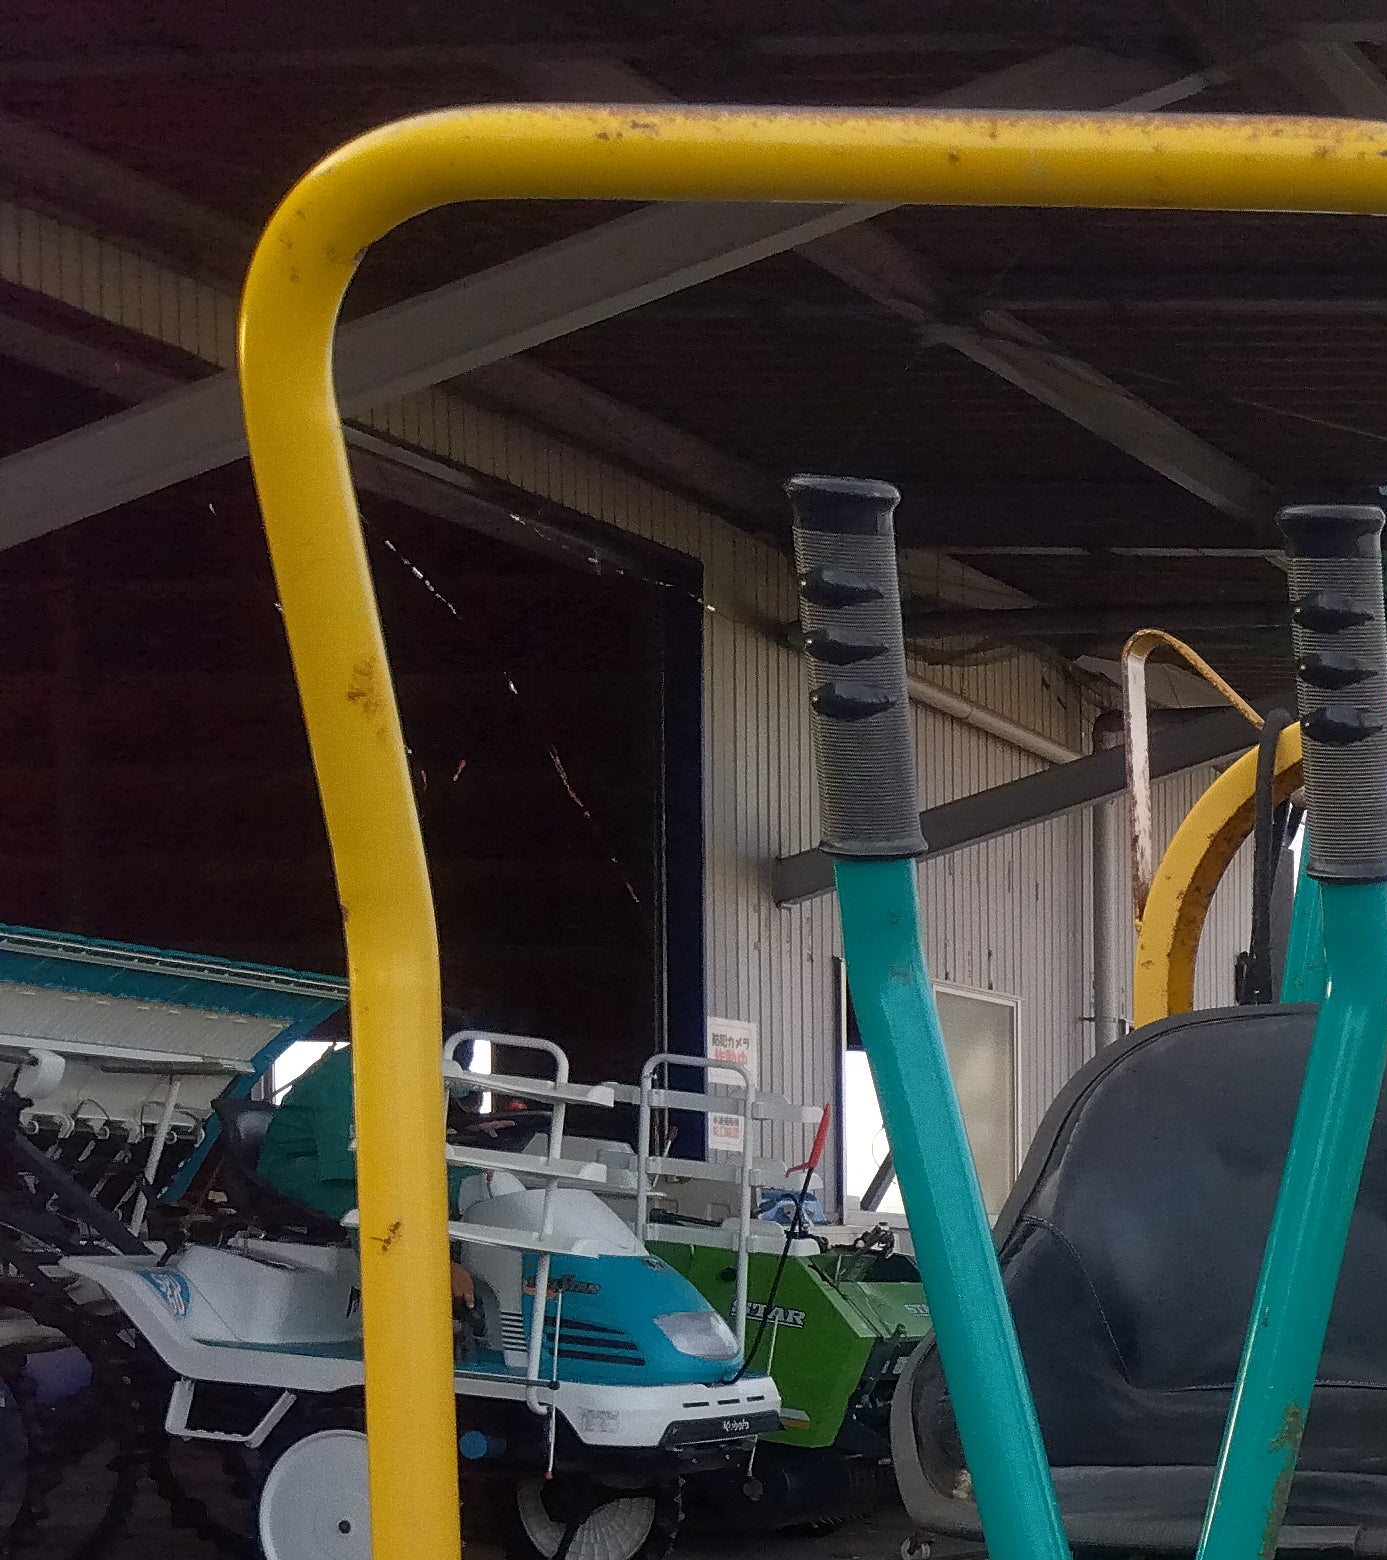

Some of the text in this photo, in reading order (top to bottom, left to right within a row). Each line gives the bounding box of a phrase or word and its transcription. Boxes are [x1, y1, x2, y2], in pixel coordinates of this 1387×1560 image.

[711, 1032, 750, 1050] 防犯カメラ
